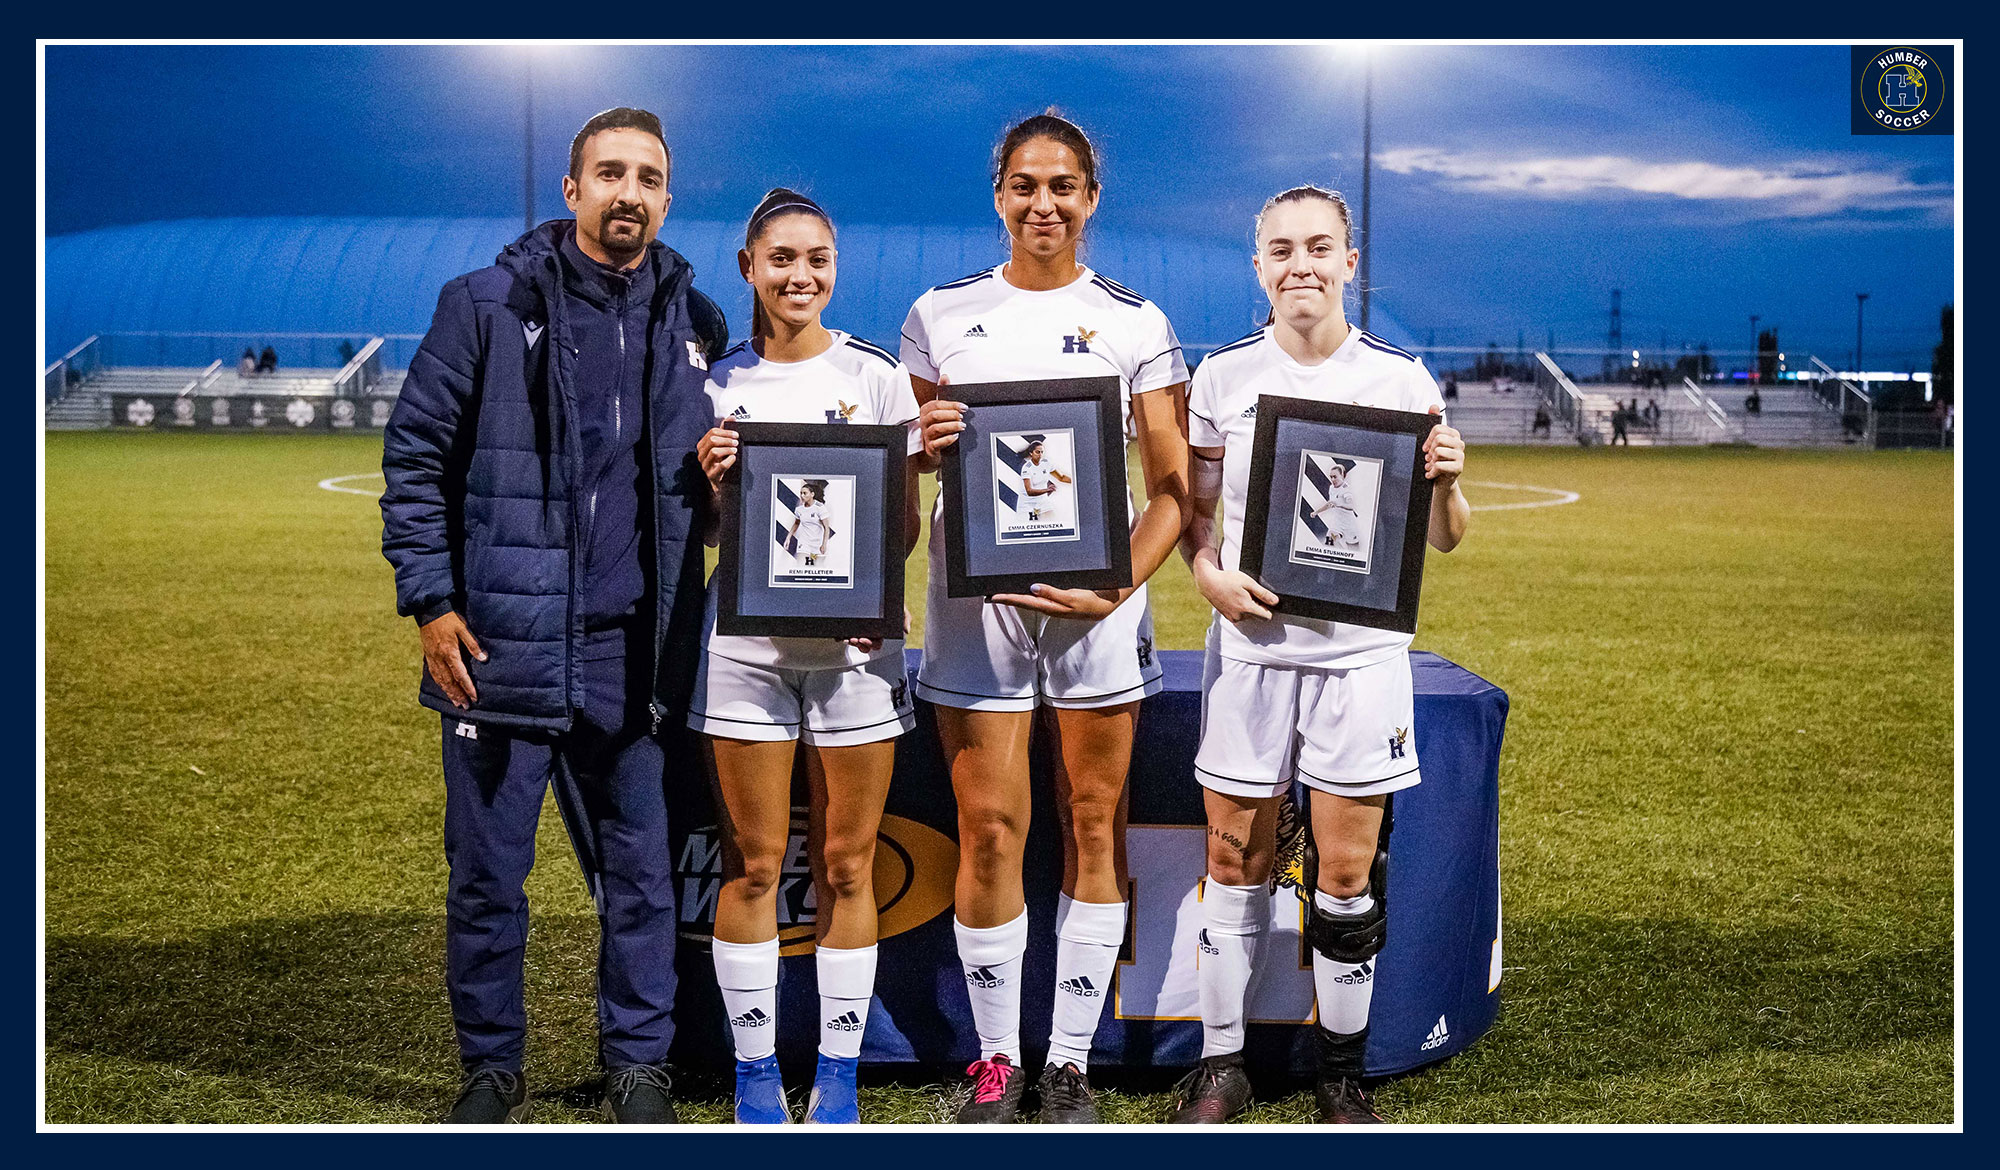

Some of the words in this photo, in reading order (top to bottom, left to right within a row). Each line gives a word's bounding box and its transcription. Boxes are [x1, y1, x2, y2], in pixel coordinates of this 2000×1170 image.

[1323, 549, 1355, 558] STUSHNOFF
[1058, 981, 1100, 998] adidas
[731, 1015, 772, 1028] adidas
[826, 1021, 864, 1032] adidas
